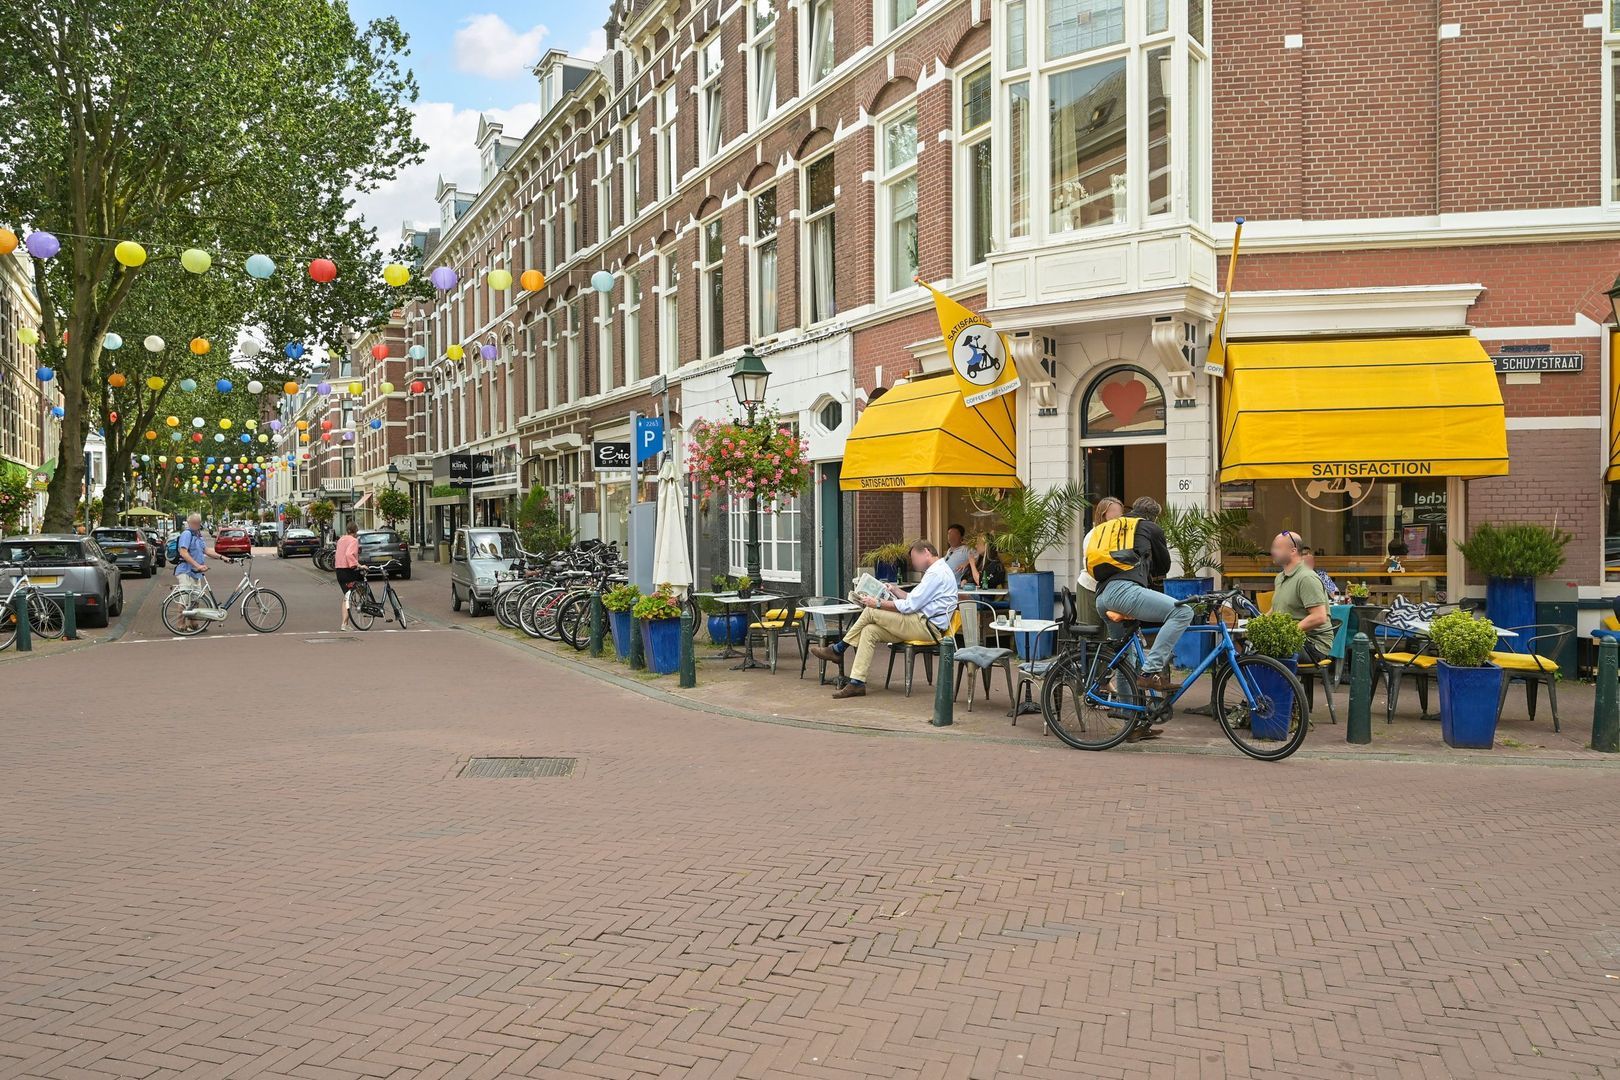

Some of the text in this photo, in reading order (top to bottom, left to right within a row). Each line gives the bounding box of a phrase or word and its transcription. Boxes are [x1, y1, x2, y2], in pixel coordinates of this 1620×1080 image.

[948, 316, 992, 341] SATISFACTI
[1502, 357, 1580, 370] SCHUYTSTRAAT
[966, 394, 986, 404] COFFEE
[1001, 381, 1018, 392] LUNCH
[644, 430, 655, 448] P
[599, 446, 631, 460] Eric
[1312, 462, 1432, 477] SATISFACTION
[861, 476, 906, 488] SATISFACTION
